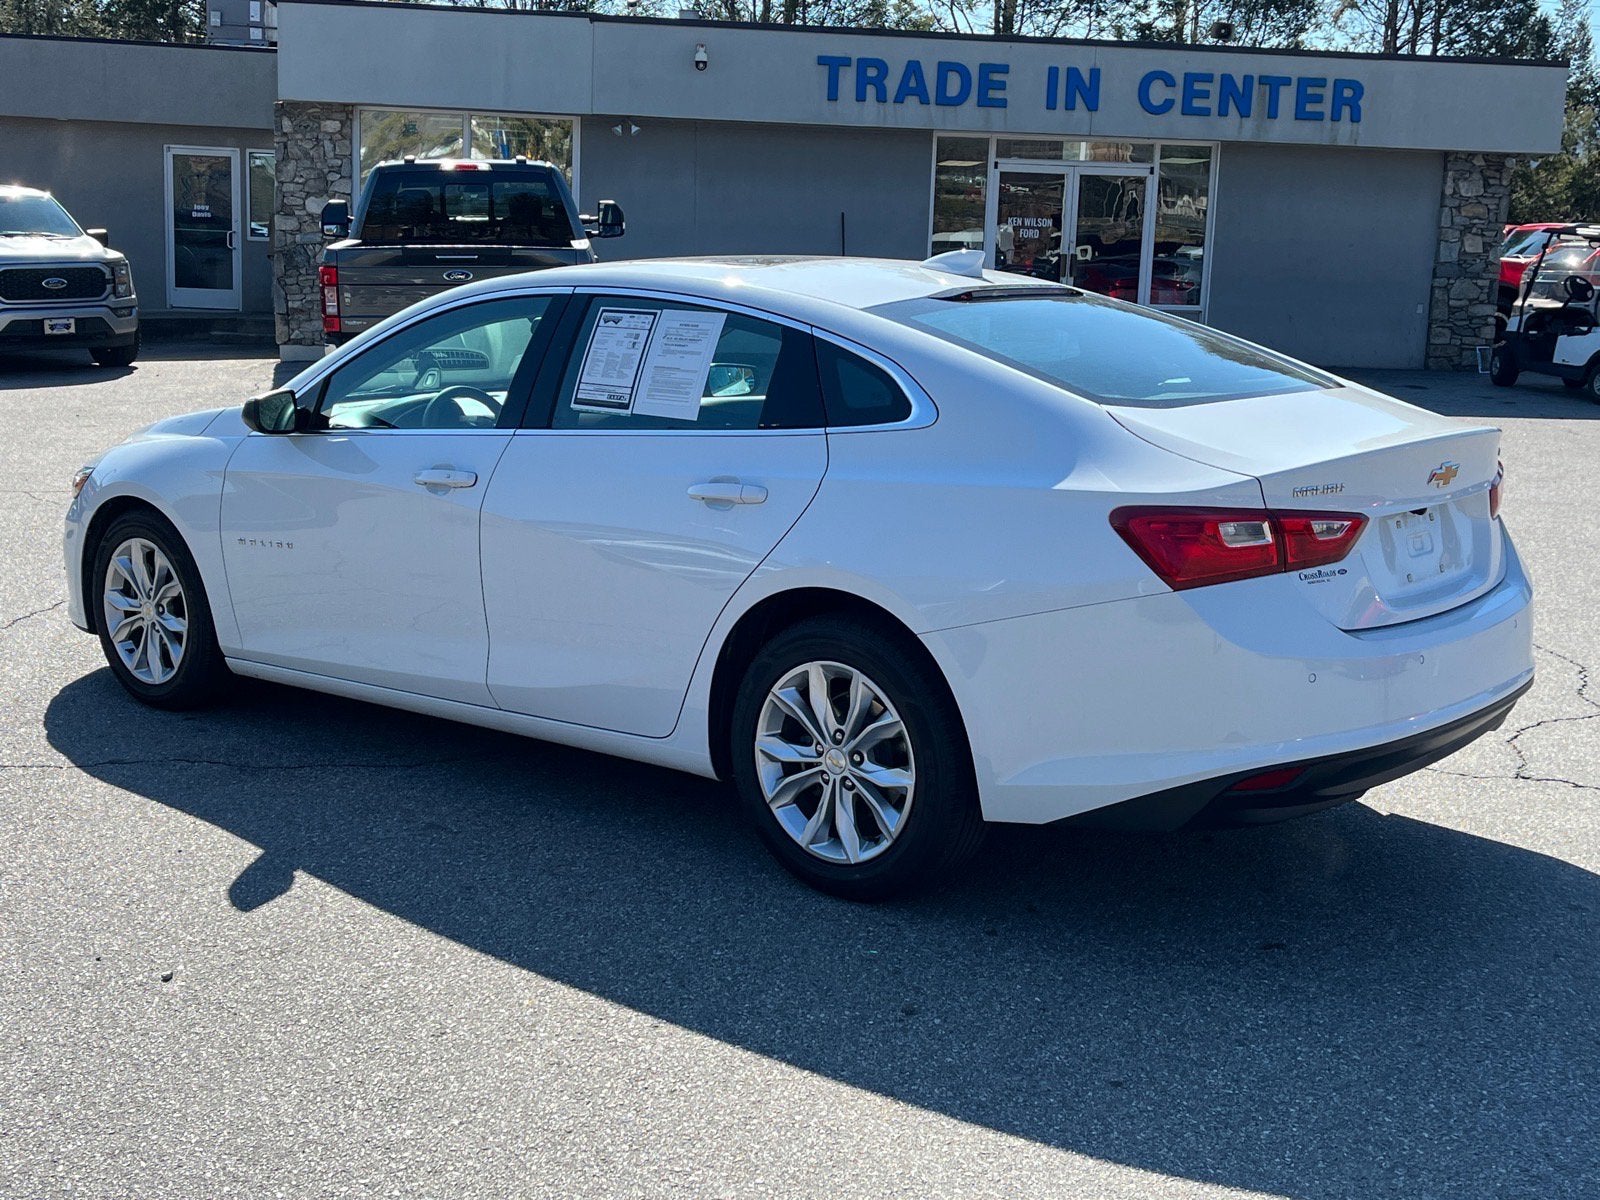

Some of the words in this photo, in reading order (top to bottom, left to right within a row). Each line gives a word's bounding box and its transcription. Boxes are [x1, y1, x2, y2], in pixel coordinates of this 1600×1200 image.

[817, 55, 1010, 108] TRADE
[1046, 66, 1101, 112] IN
[1138, 70, 1365, 123] CENTER
[1007, 216, 1023, 227] KEN
[1024, 217, 1053, 228] WILSON
[1019, 228, 1040, 239] FORD
[1292, 482, 1346, 498] MALIBU
